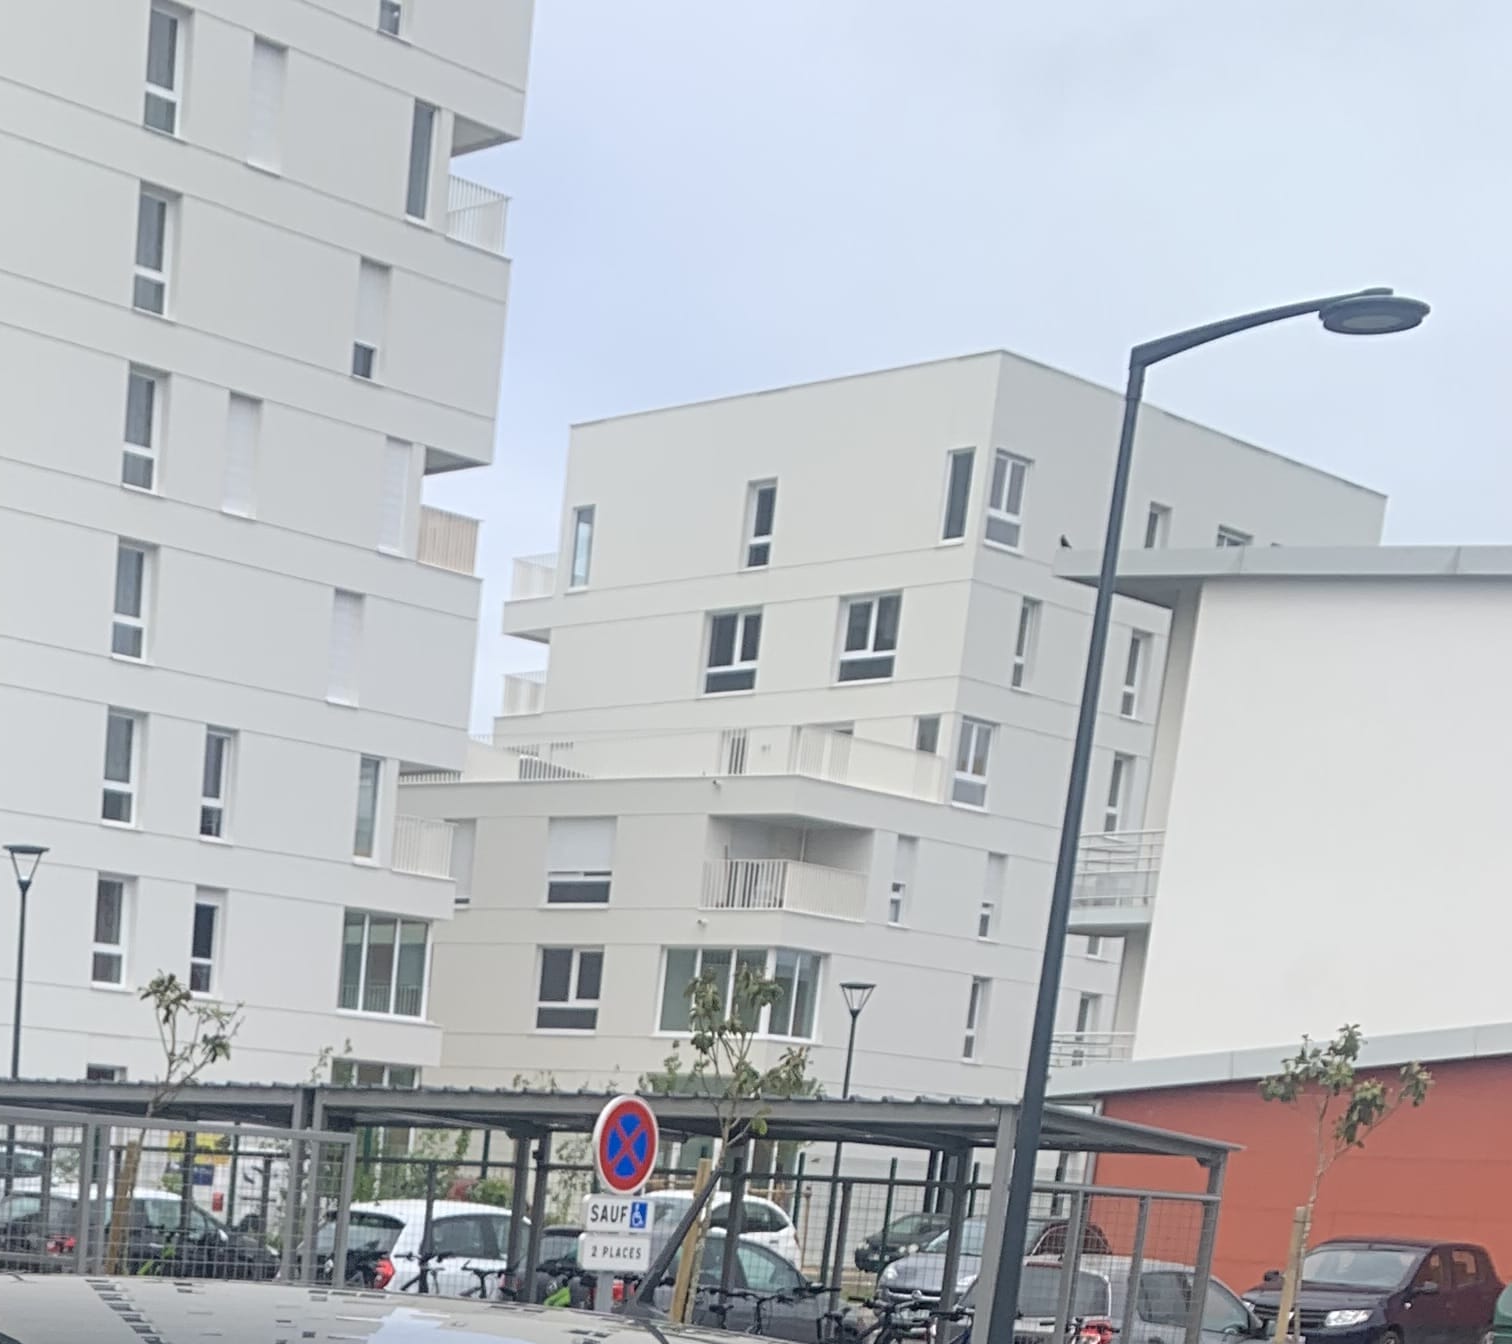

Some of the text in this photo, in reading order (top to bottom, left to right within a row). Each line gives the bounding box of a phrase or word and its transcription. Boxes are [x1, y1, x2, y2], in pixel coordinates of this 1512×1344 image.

[590, 1204, 628, 1223] SAUF
[591, 1245, 642, 1259] 2 PLACES
